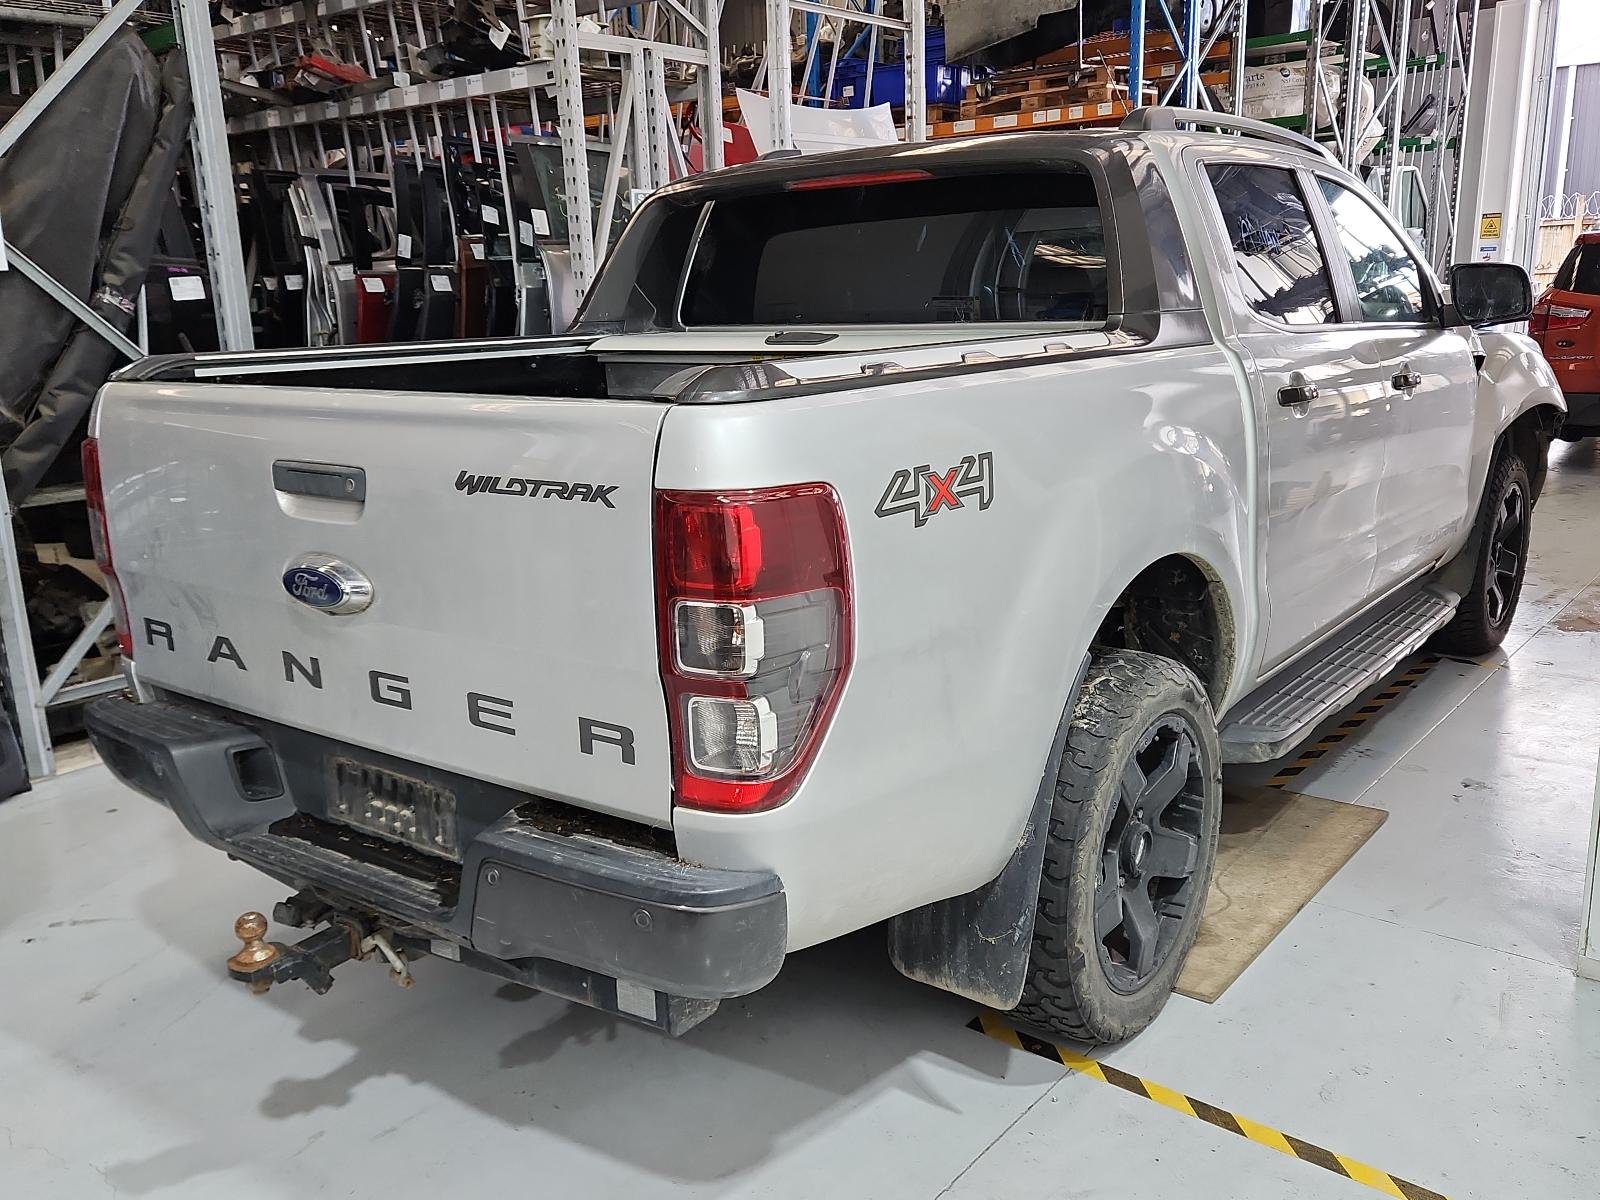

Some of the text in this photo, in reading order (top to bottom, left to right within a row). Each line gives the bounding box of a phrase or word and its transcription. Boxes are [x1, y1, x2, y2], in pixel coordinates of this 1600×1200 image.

[455, 470, 619, 508] WILDTRAK
[292, 573, 328, 600] Ford
[143, 617, 636, 765] RANGER
